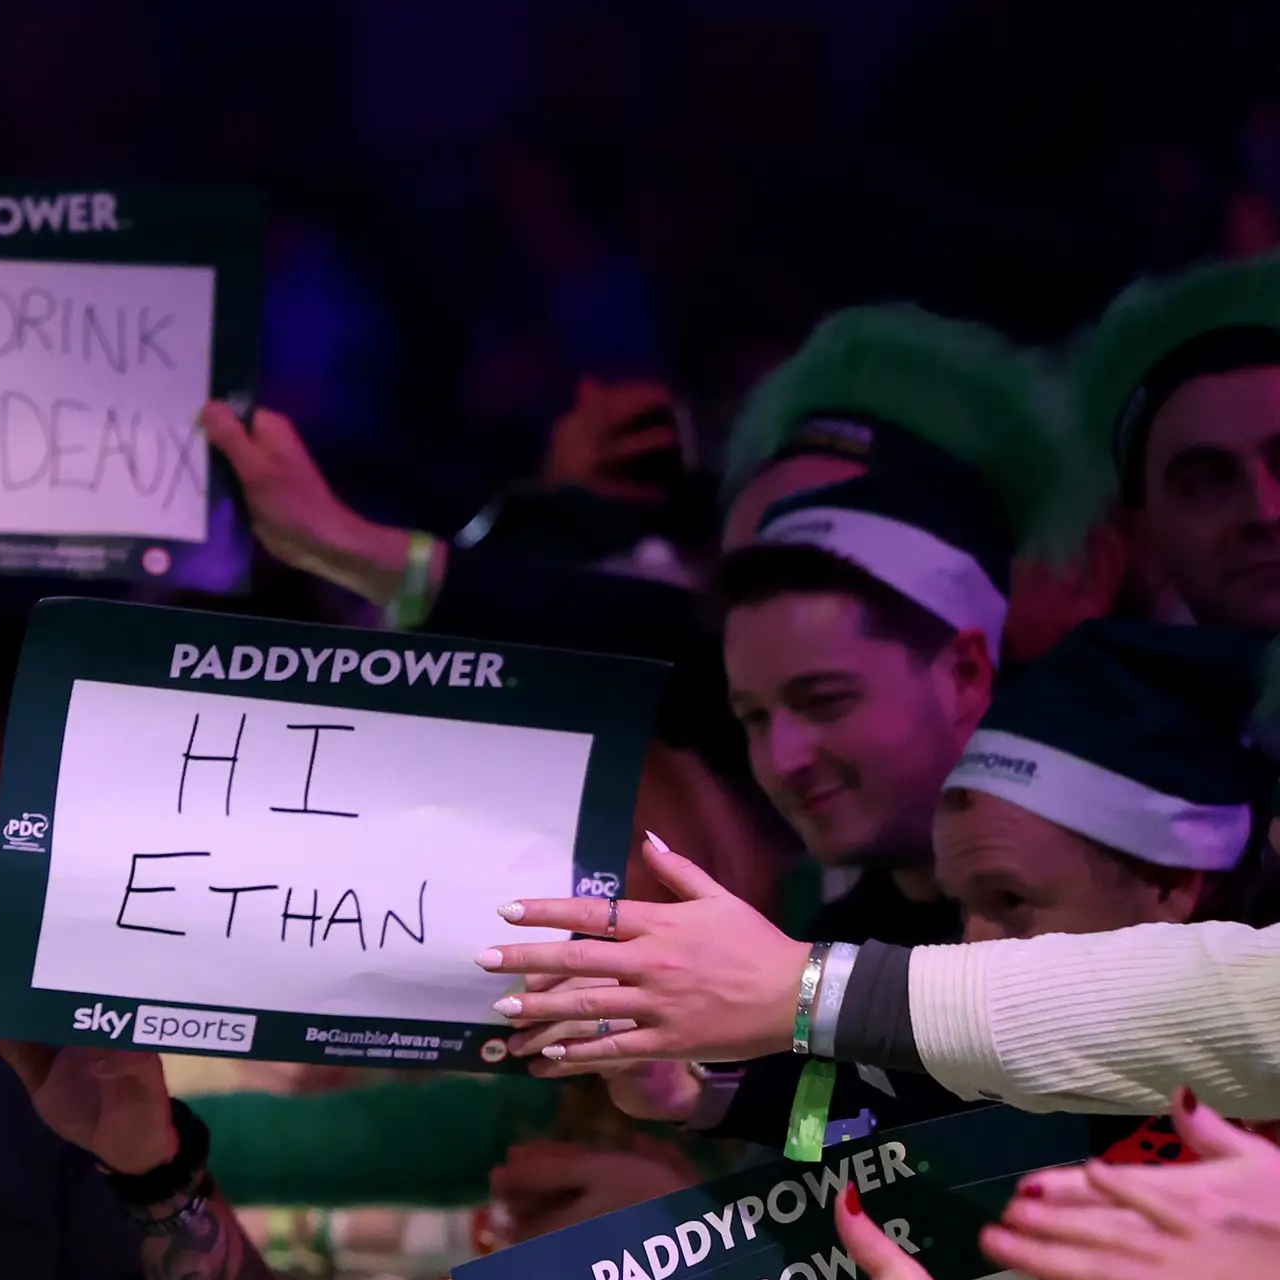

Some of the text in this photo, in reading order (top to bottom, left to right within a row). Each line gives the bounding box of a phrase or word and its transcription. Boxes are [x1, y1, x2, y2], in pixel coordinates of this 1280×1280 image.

[177, 712, 359, 818] HI
[8, 819, 45, 838] PDC
[116, 851, 428, 951] ETHAN
[580, 877, 616, 897] PDC
[73, 1003, 132, 1040] sky
[141, 1012, 247, 1042] sports
